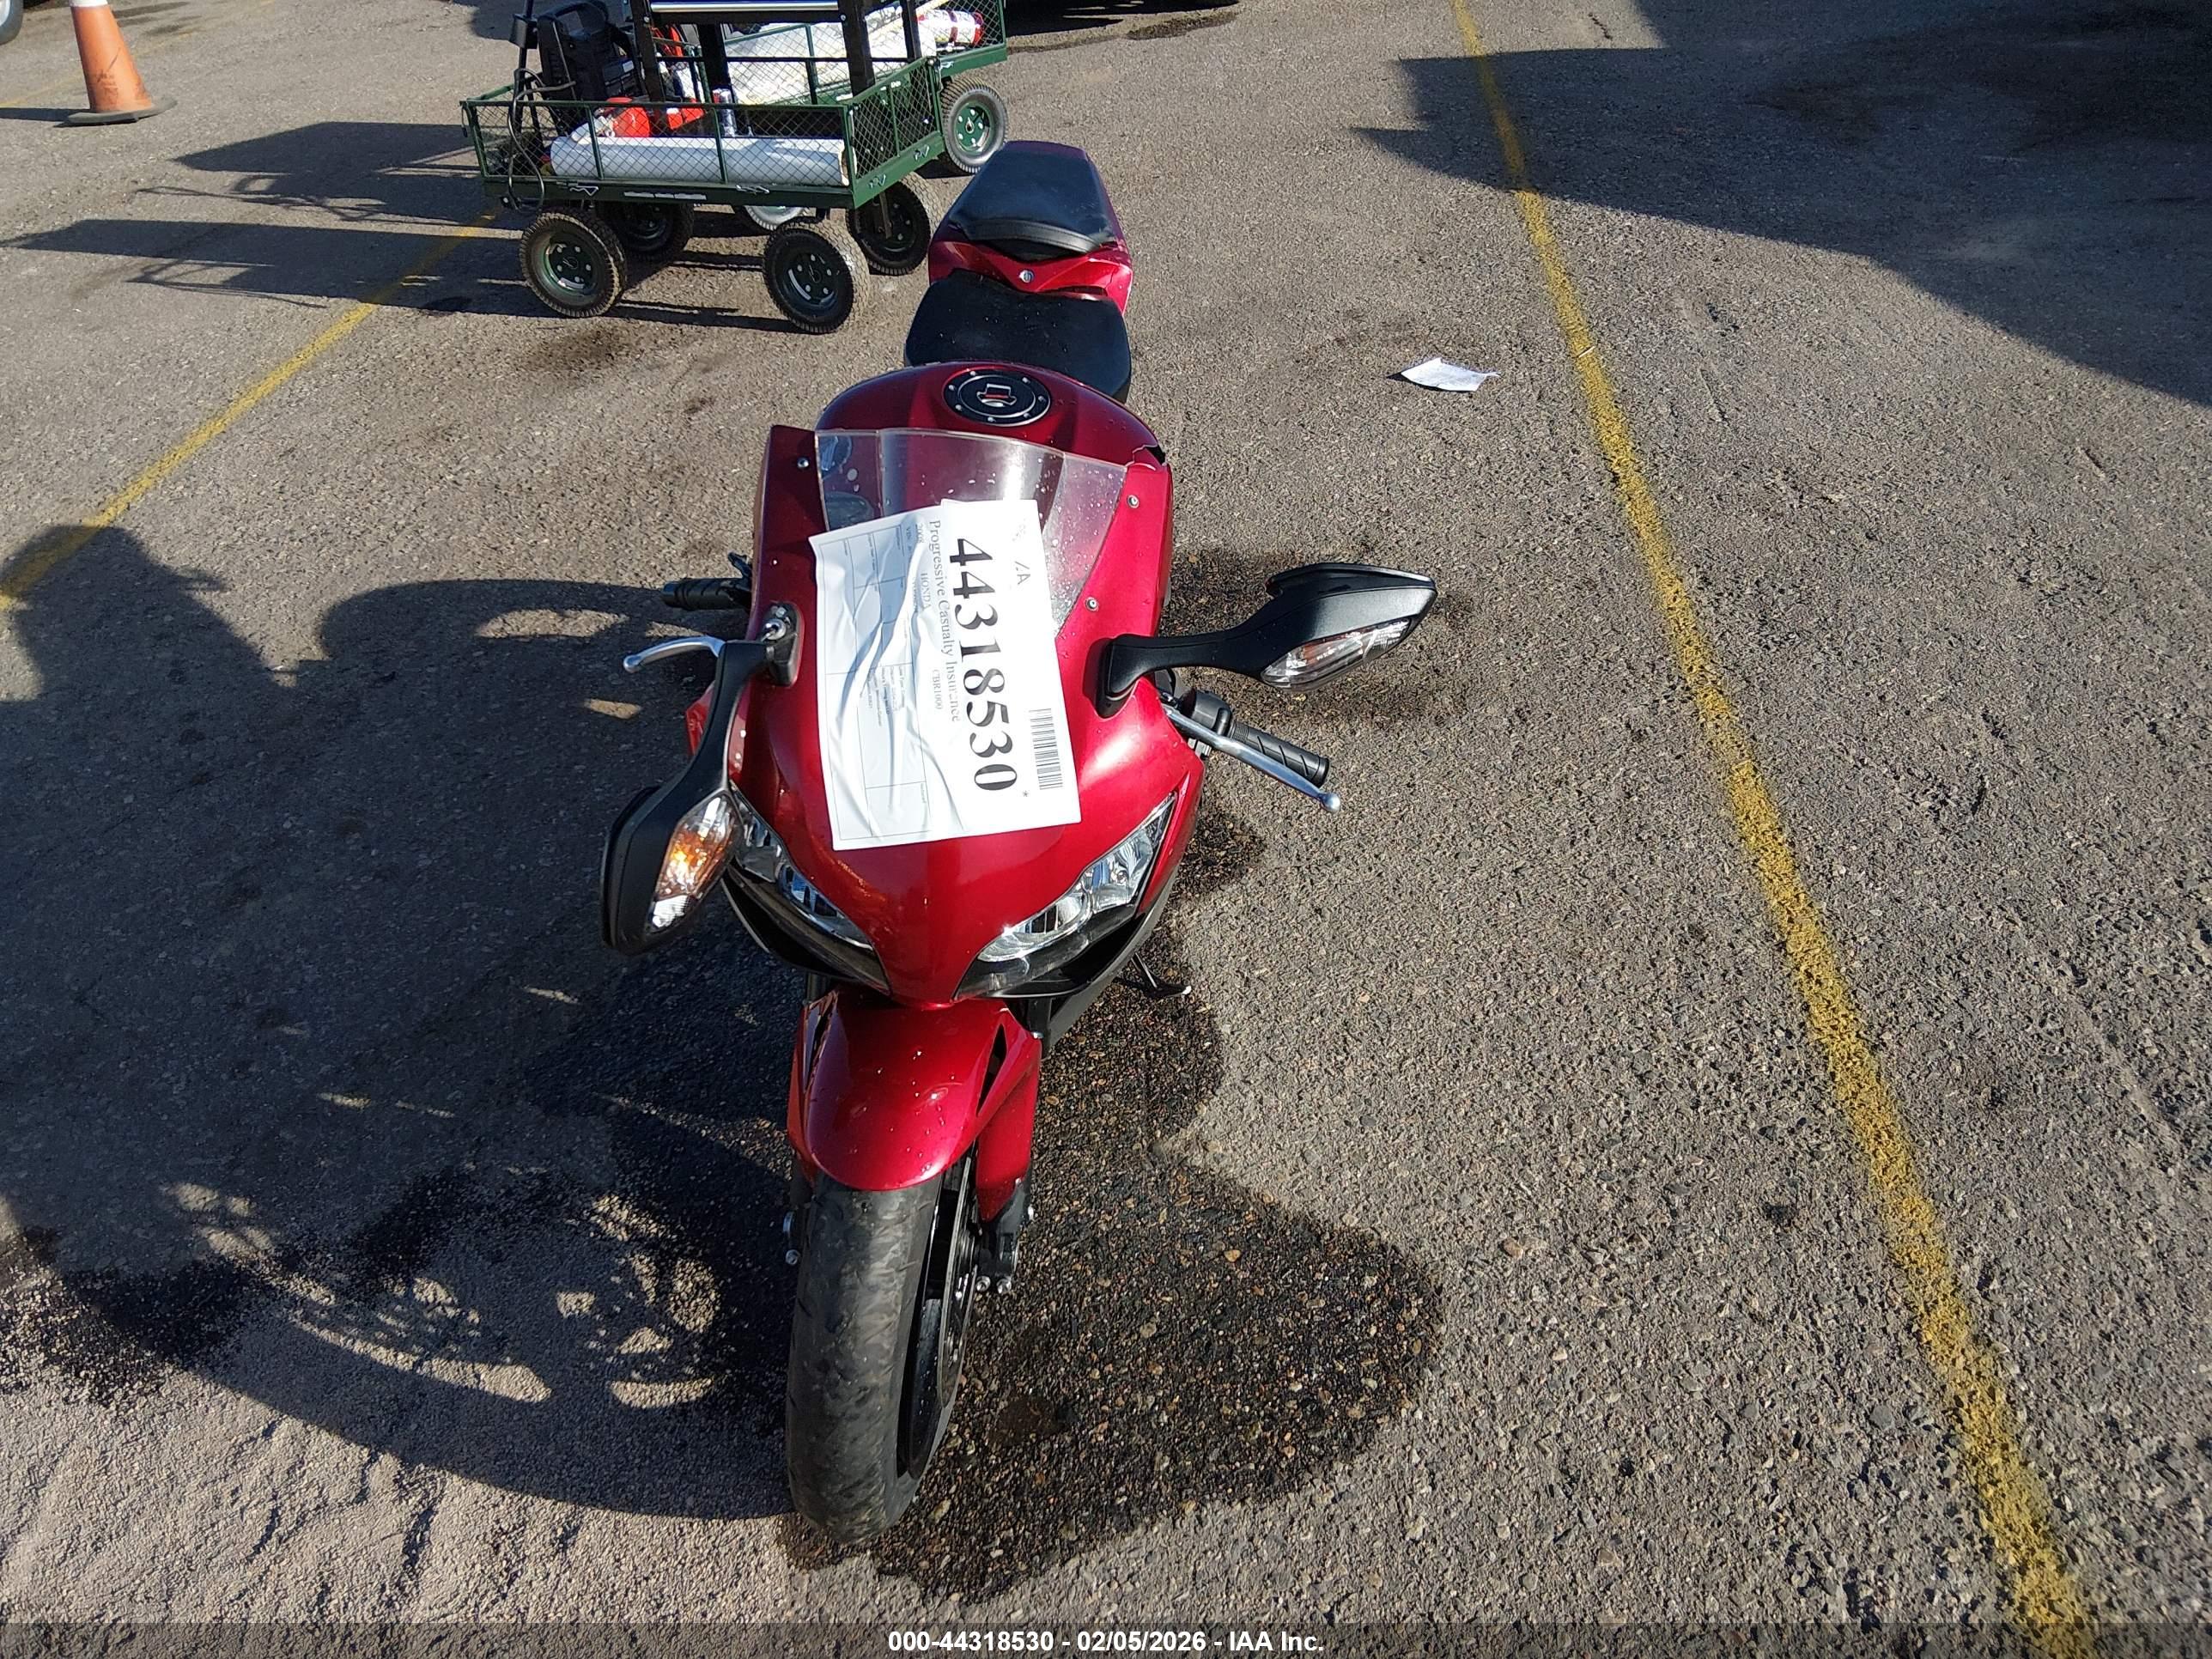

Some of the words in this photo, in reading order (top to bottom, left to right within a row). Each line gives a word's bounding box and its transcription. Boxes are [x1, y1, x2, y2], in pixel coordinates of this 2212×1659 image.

[921, 572, 932, 610] HONDA
[932, 669, 944, 710] CBR1000
[928, 520, 948, 596] Progressive
[938, 599, 956, 657] Casualty
[948, 538, 1019, 793] 44318530
